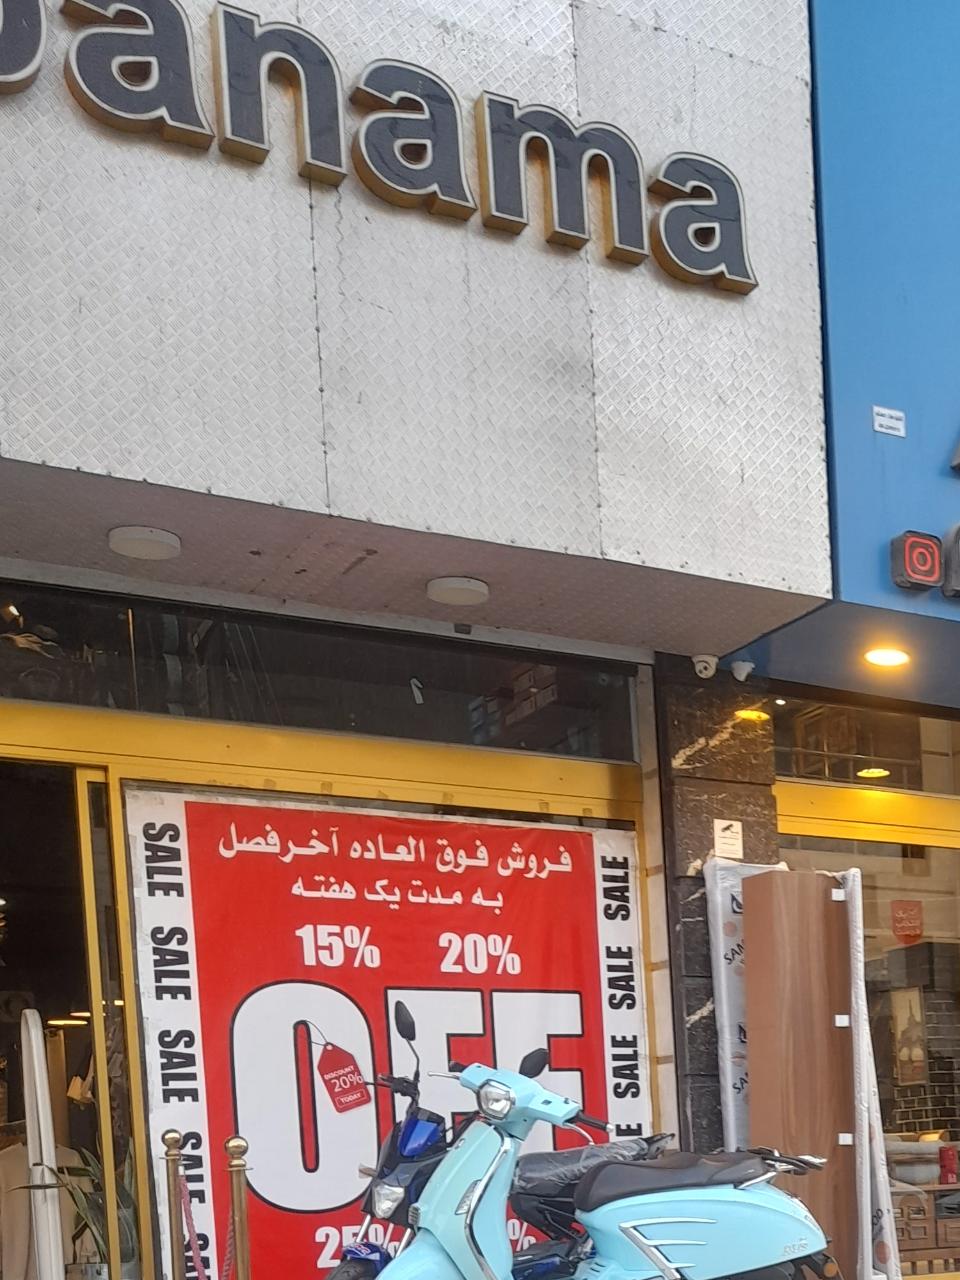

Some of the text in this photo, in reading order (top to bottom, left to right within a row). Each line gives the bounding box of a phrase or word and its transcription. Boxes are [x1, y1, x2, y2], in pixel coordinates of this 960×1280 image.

[143, 822, 184, 898] SALE
[349, 832, 426, 863] العاده
[436, 838, 489, 874] فوق
[497, 843, 573, 880] فروش
[290, 874, 504, 915] به مدت یک هفته
[600, 855, 631, 921] SALE
[150, 926, 192, 1001] SALE
[294, 923, 522, 976] 15% 20%
[605, 945, 636, 1011] SALE
[157, 1029, 199, 1104] SALE
[230, 978, 584, 1214] OFF
[330, 1071, 365, 1093] 20%
[611, 1034, 641, 1099] SALE
[339, 1092, 362, 1104] TODAY
